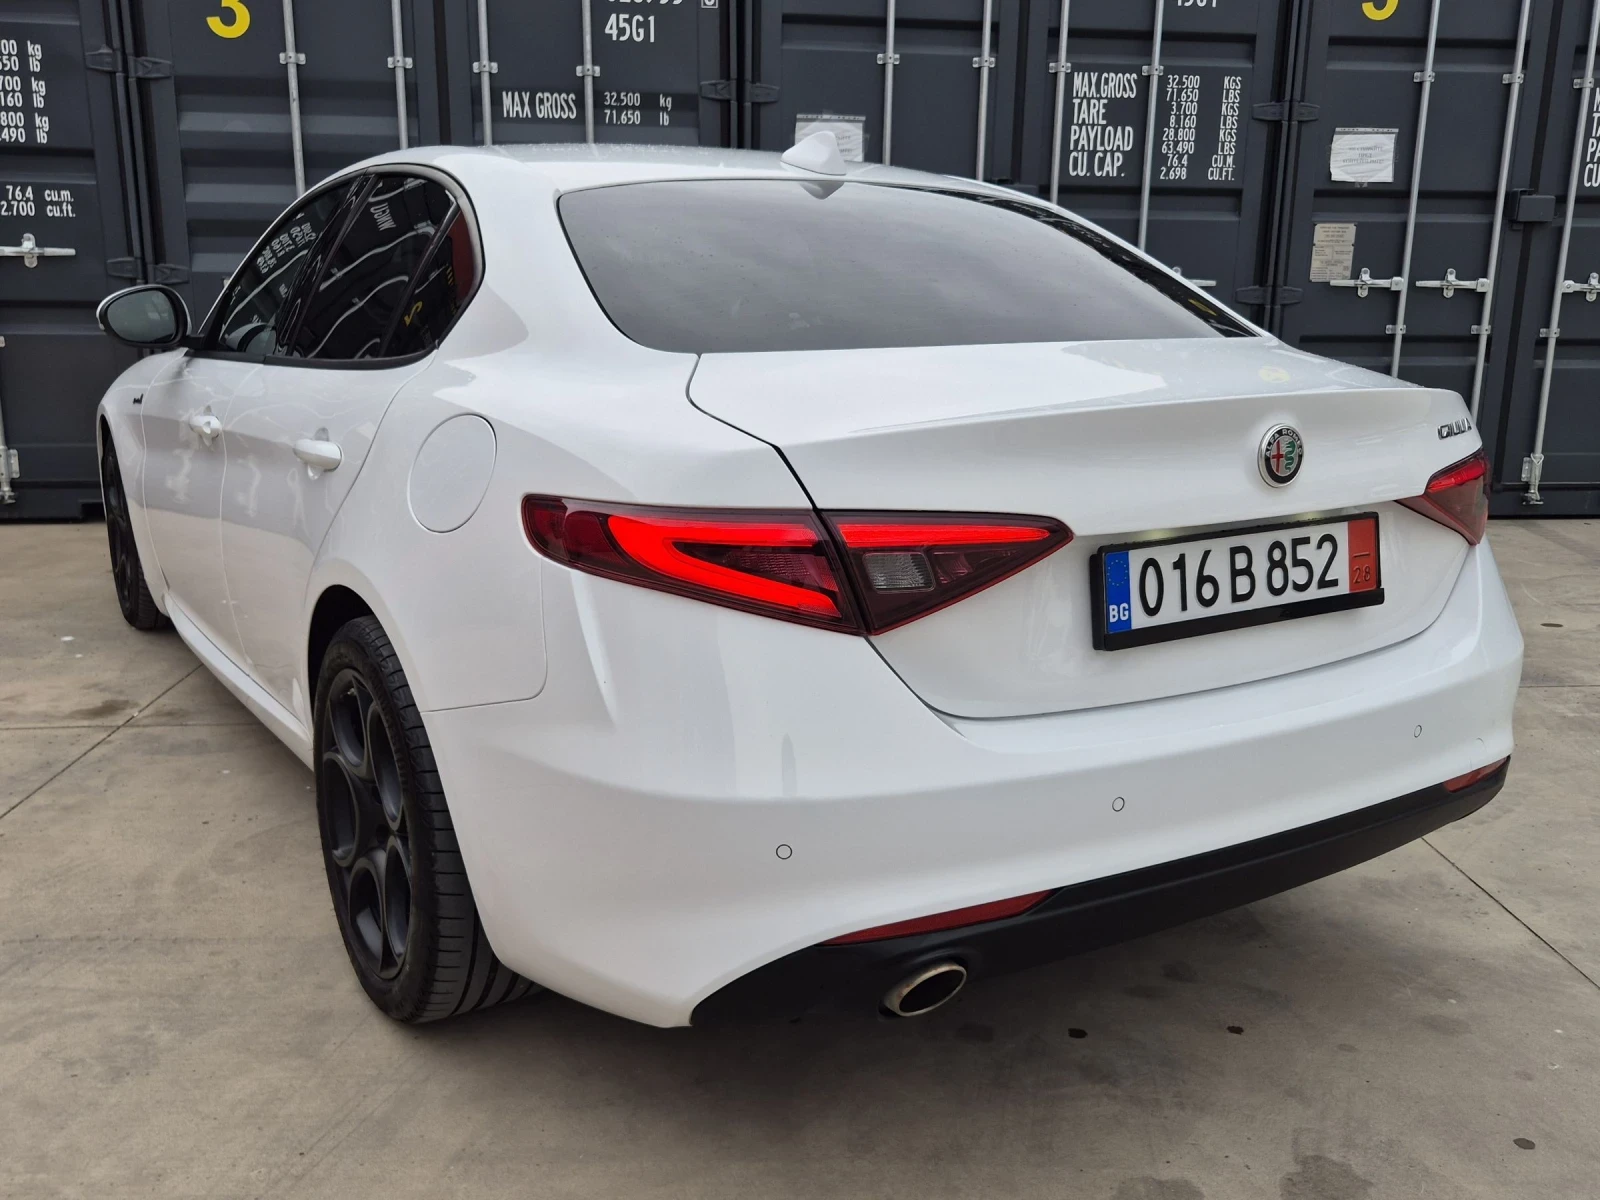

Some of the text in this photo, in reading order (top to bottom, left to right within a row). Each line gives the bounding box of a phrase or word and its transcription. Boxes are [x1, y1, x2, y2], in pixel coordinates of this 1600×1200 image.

[604, 13, 655, 43] 45G1
[27, 40, 42, 60] kg
[29, 56, 41, 72] lb
[31, 76, 46, 96] kg
[1167, 75, 1200, 89] 32.500
[1224, 76, 1242, 90] KGS
[33, 92, 44, 108] lb
[502, 91, 672, 119] MAX GROSS 32.500 kg
[1166, 88, 1241, 103] 71.650 LBS
[604, 109, 670, 126] 71.650 lb
[1072, 98, 1240, 125] TARE 3.700 KGS
[1169, 114, 1239, 129] 8.160 LBS
[35, 112, 49, 132] kg
[36, 128, 48, 144] lb
[1069, 125, 1237, 151] PAYLOAD 28.800 KGS
[1161, 140, 1236, 155] 63.490 LBS
[1068, 151, 1236, 177] CU. CAP. 76.4 CU.M.
[1159, 167, 1235, 181] 2.698 CU.FT.
[5, 185, 34, 201] 76.4
[1139, 533, 1339, 617] 016 B 852
[1353, 564, 1371, 584] 28
[1109, 603, 1129, 623] BG
